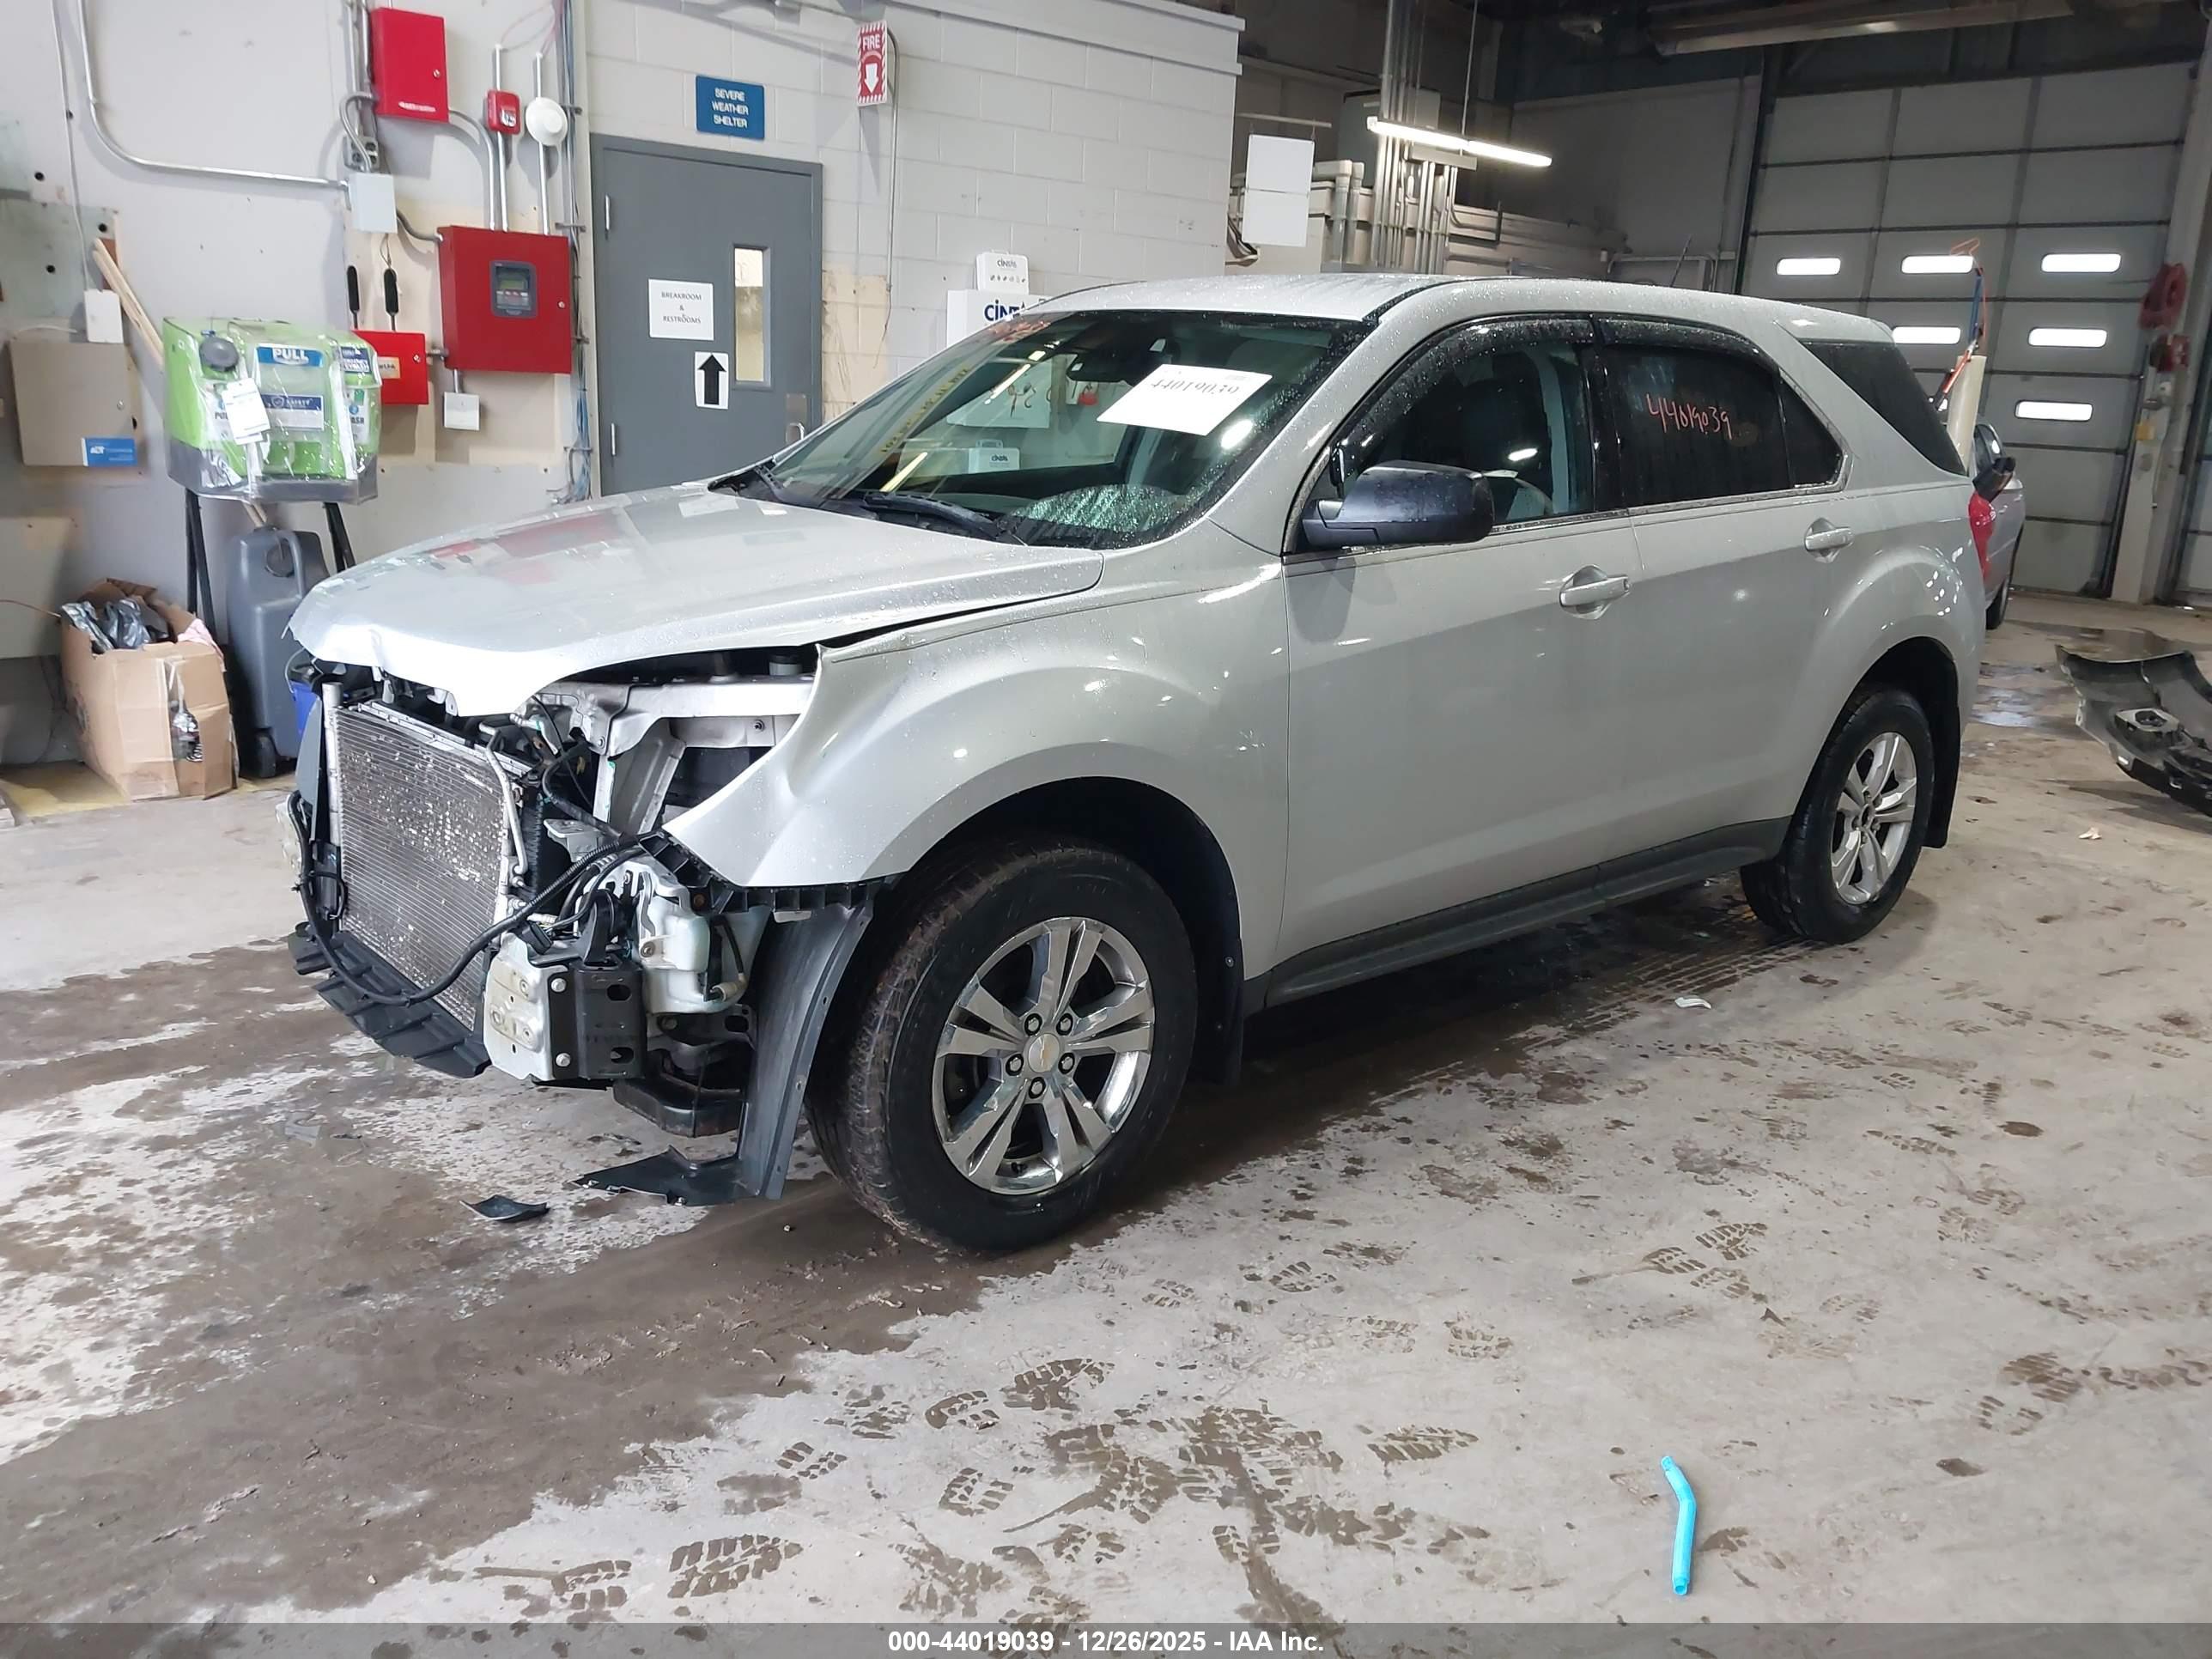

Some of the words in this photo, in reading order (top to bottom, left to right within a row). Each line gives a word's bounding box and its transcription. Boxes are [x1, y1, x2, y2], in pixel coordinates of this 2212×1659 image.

[862, 34, 881, 51] FIRE
[714, 87, 745, 101] SEVERE
[711, 100, 749, 115] WEATHER
[714, 114, 748, 129] SHELTER
[661, 291, 702, 301] BREAKROOM
[662, 315, 702, 325] RESTROOMS
[272, 348, 309, 362] PULL
[1646, 393, 1733, 441] 44019039
